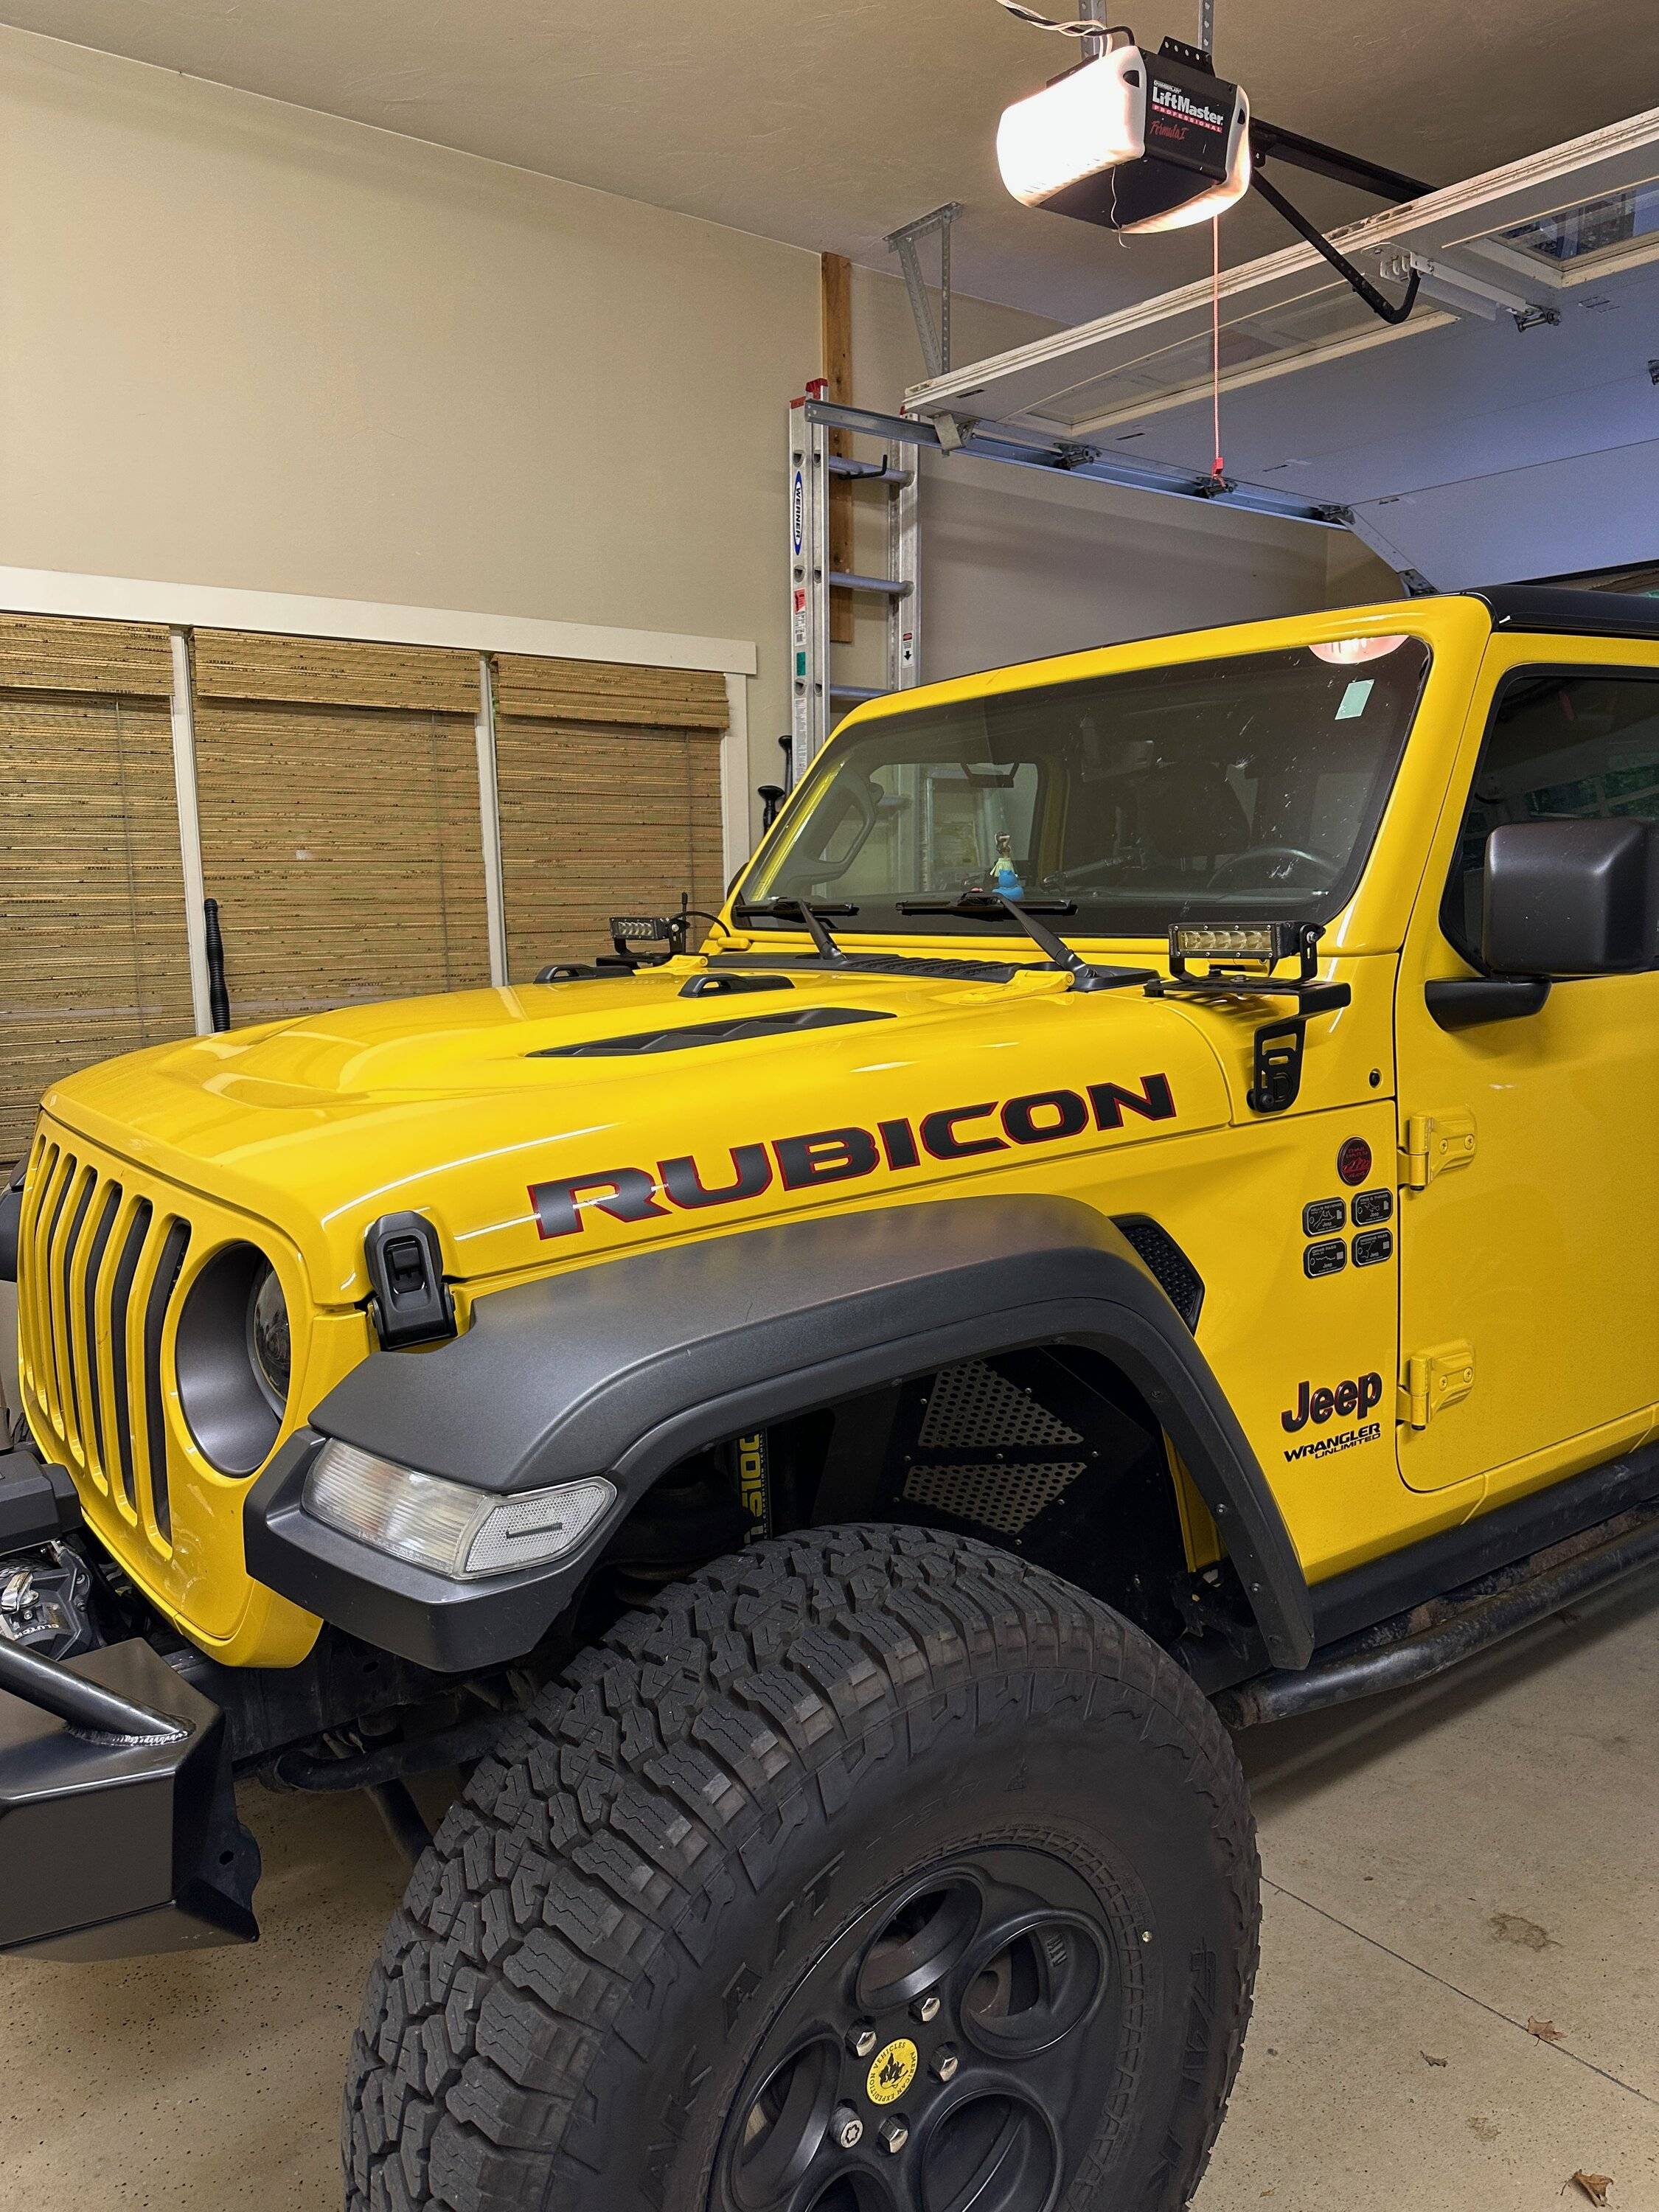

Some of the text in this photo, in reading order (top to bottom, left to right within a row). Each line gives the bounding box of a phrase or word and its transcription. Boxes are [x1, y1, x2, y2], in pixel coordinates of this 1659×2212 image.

[1152, 86, 1223, 125] LiftMaster
[1153, 105, 1222, 134] PROFESSIONAL
[526, 1073, 1178, 1241] RUBICON
[1281, 1371, 1382, 1433] Jeep
[1283, 1422, 1381, 1463] WRANGLER
[1315, 1433, 1381, 1459] UNLIMITED
[14, 1623, 60, 1639] CLUTCH
[869, 2042, 917, 2102] AMERICAN EXPEDITION VEHICLES
